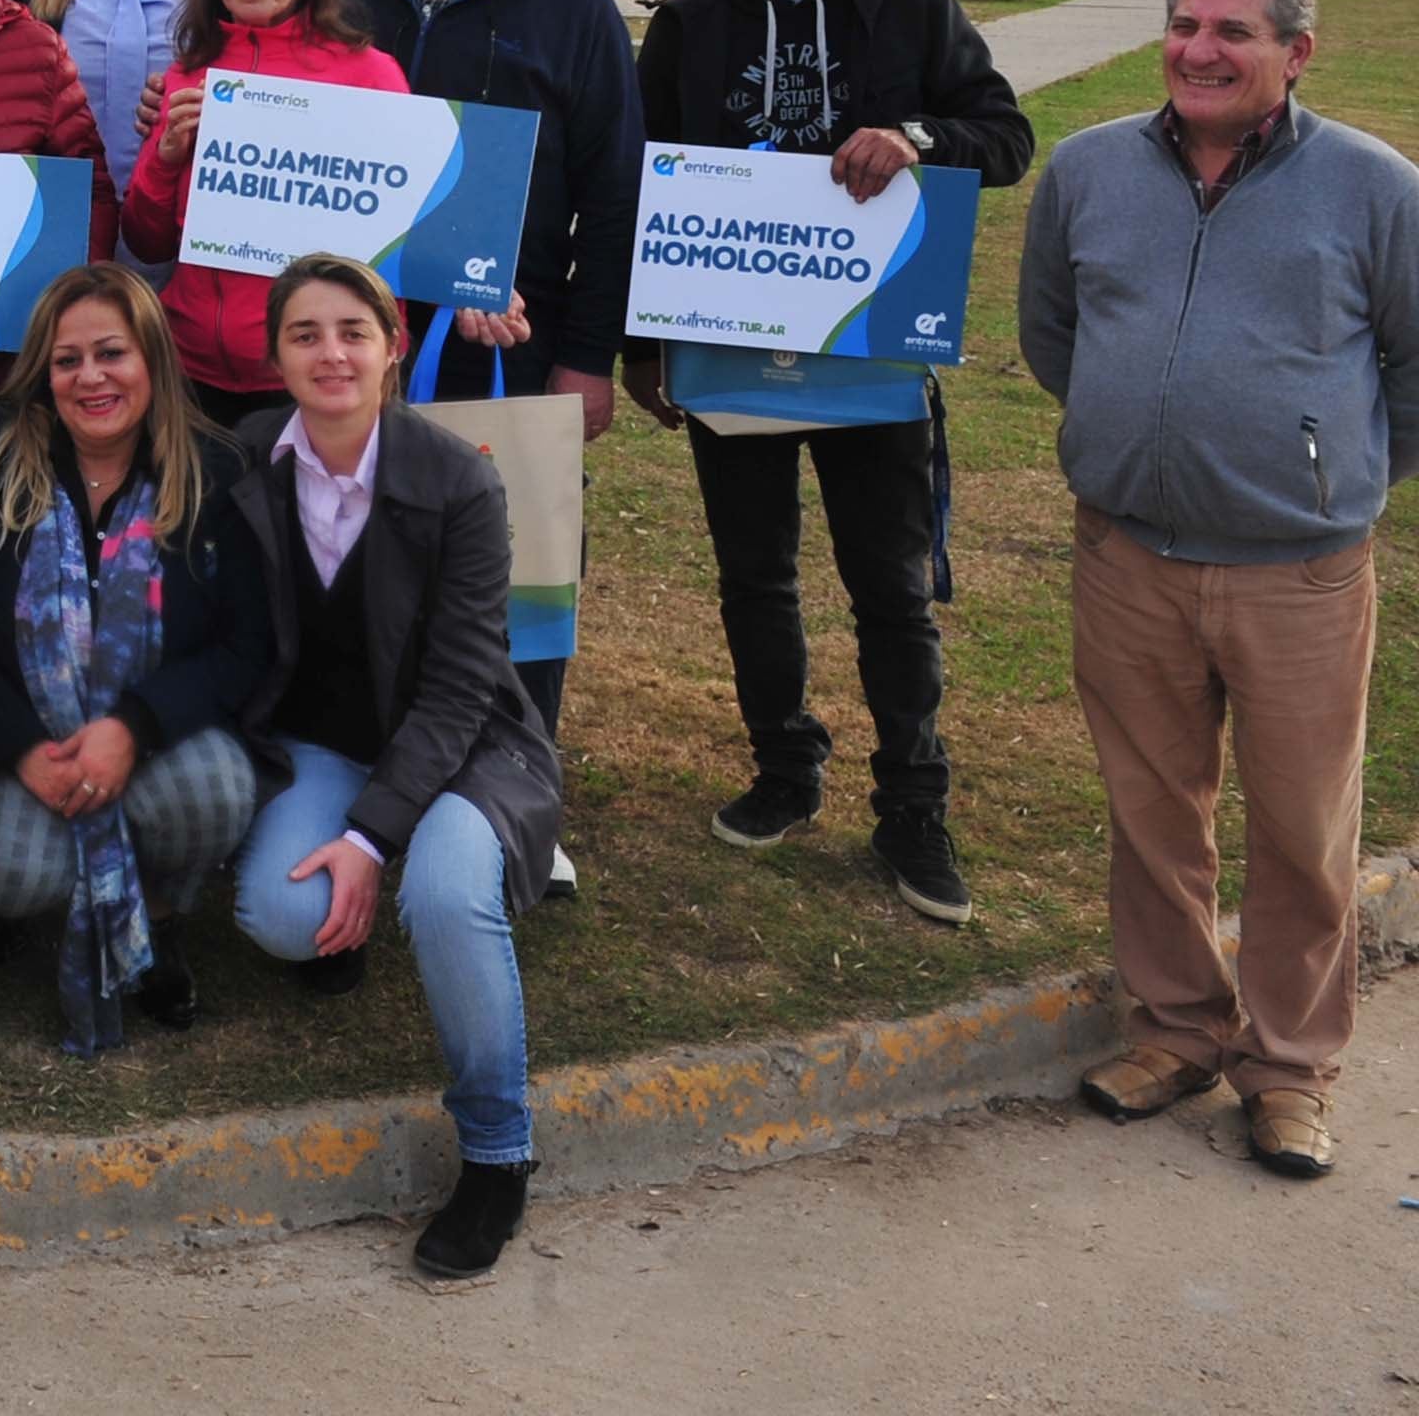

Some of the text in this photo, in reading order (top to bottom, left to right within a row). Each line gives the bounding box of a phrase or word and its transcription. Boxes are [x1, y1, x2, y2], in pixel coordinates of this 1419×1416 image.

[772, 87, 823, 106] PSTATE
[779, 107, 810, 121] DEPT
[202, 139, 408, 188] ALOJAMIENTO
[197, 166, 379, 216] HABILITADO
[645, 212, 855, 251] ALOJAMIENTO
[640, 239, 871, 283] HOMOLOGADO
